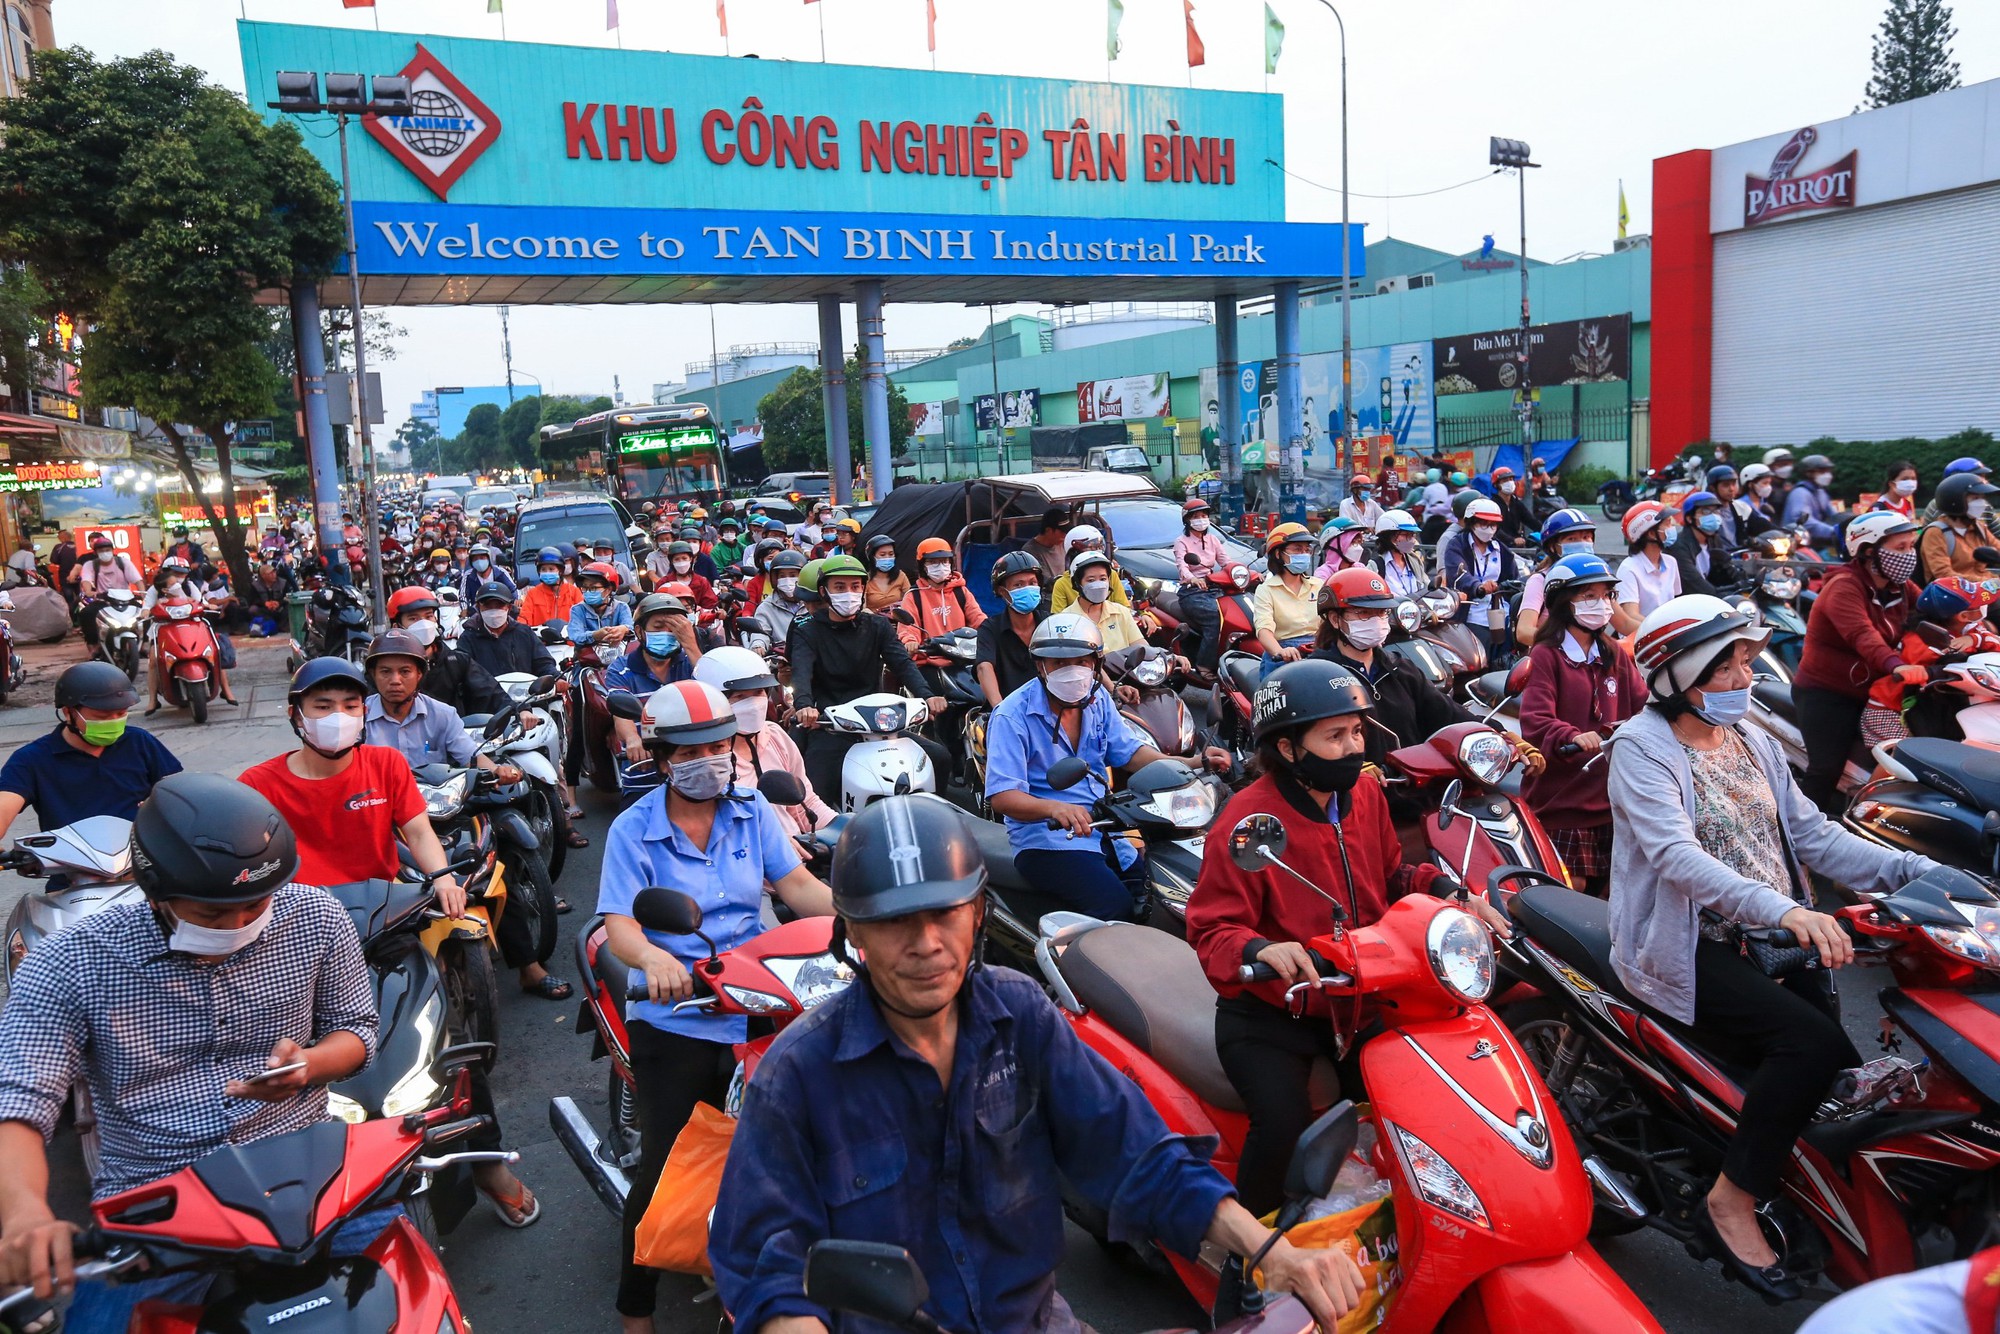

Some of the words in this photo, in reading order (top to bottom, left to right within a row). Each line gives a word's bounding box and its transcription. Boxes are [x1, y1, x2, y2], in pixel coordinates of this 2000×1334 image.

[388, 115, 476, 133] TANIMEX
[562, 102, 678, 164] KHU
[701, 96, 840, 171] CÔNG
[859, 112, 1029, 190] NGHIỆP
[1043, 117, 1127, 183] TÂN
[1144, 119, 1236, 185] BÌNH
[1747, 170, 1852, 217] PARROT
[373, 220, 620, 260] Welcome
[637, 231, 685, 260] to
[702, 226, 822, 261] TAN
[842, 227, 976, 261] BINH
[990, 230, 1178, 263] Industrial
[1189, 232, 1266, 264] Park
[1100, 403, 1121, 415] PARROT
[625, 436, 668, 452] Kim
[670, 432, 711, 448] Anh
[1055, 625, 1068, 633] TC
[731, 849, 747, 860] TC
[1430, 1214, 1468, 1241] SYM
[266, 1295, 333, 1326] HONDA
